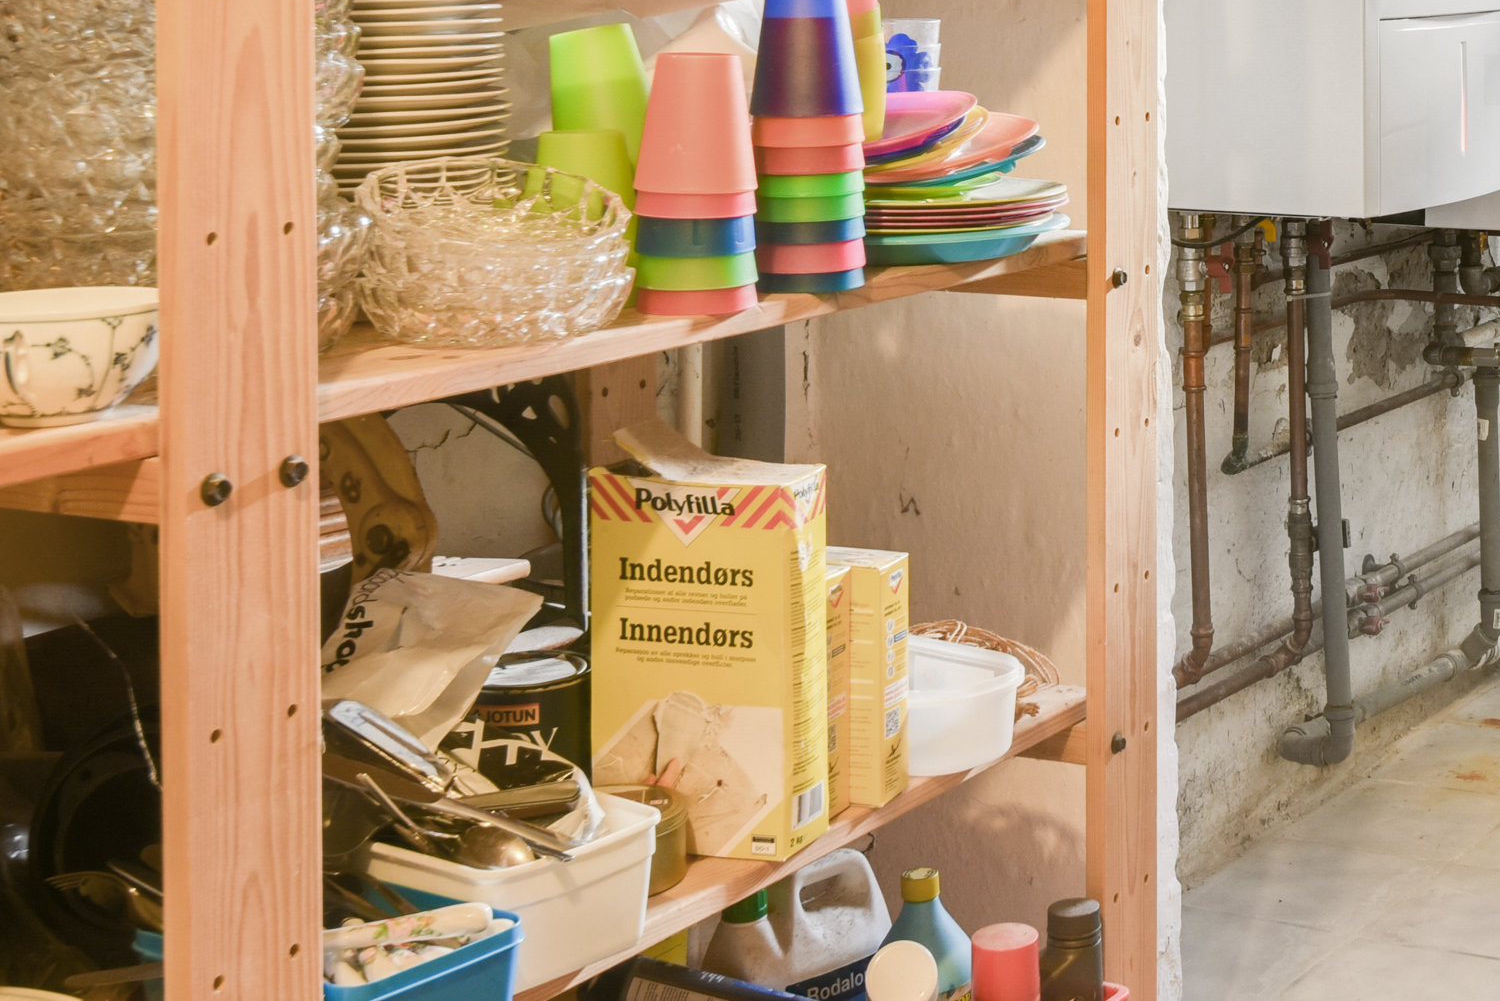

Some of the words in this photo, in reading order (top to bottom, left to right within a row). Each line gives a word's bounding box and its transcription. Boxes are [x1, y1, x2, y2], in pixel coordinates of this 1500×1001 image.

[634, 487, 735, 516] Polyfilla
[618, 556, 754, 588] Indendørs
[619, 617, 754, 649] Innendørs
[485, 709, 536, 724] JOTUN
[807, 970, 867, 1001] Rodalo
